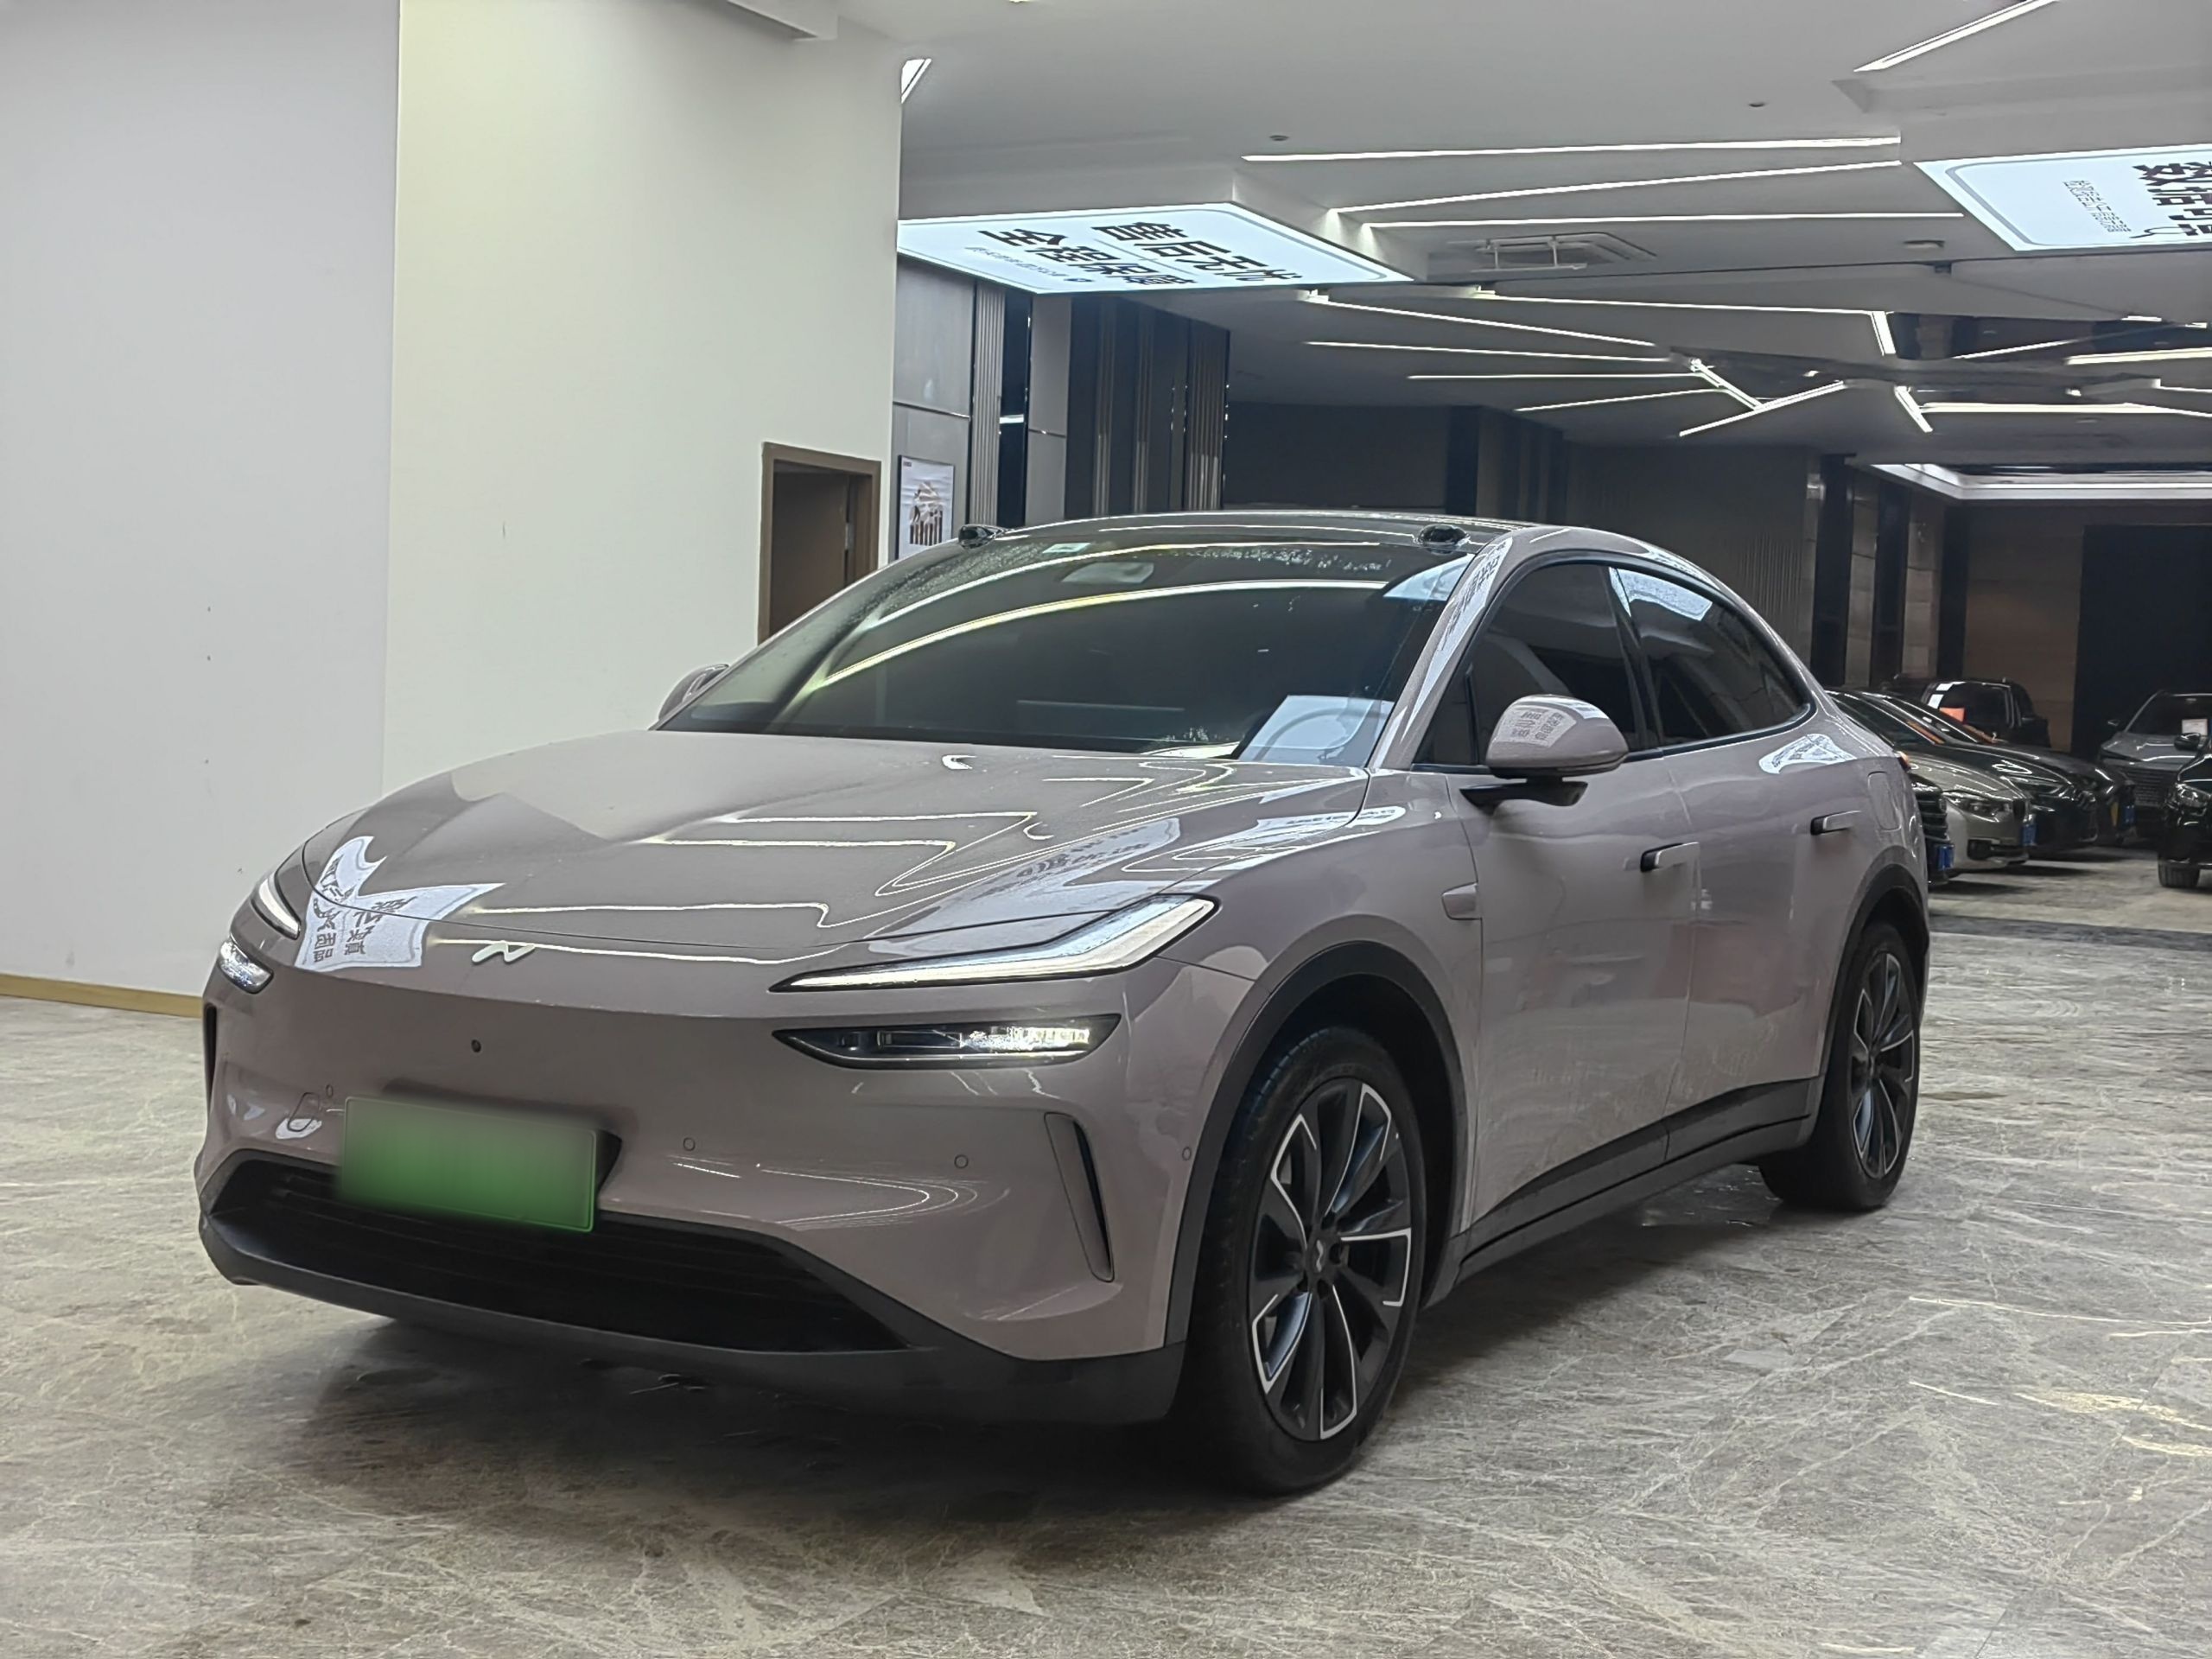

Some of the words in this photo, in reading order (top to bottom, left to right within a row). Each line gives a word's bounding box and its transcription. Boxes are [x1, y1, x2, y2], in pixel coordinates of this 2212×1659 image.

[977, 228, 1197, 285] 全程保障
[1091, 221, 1303, 282] 售后无忧
